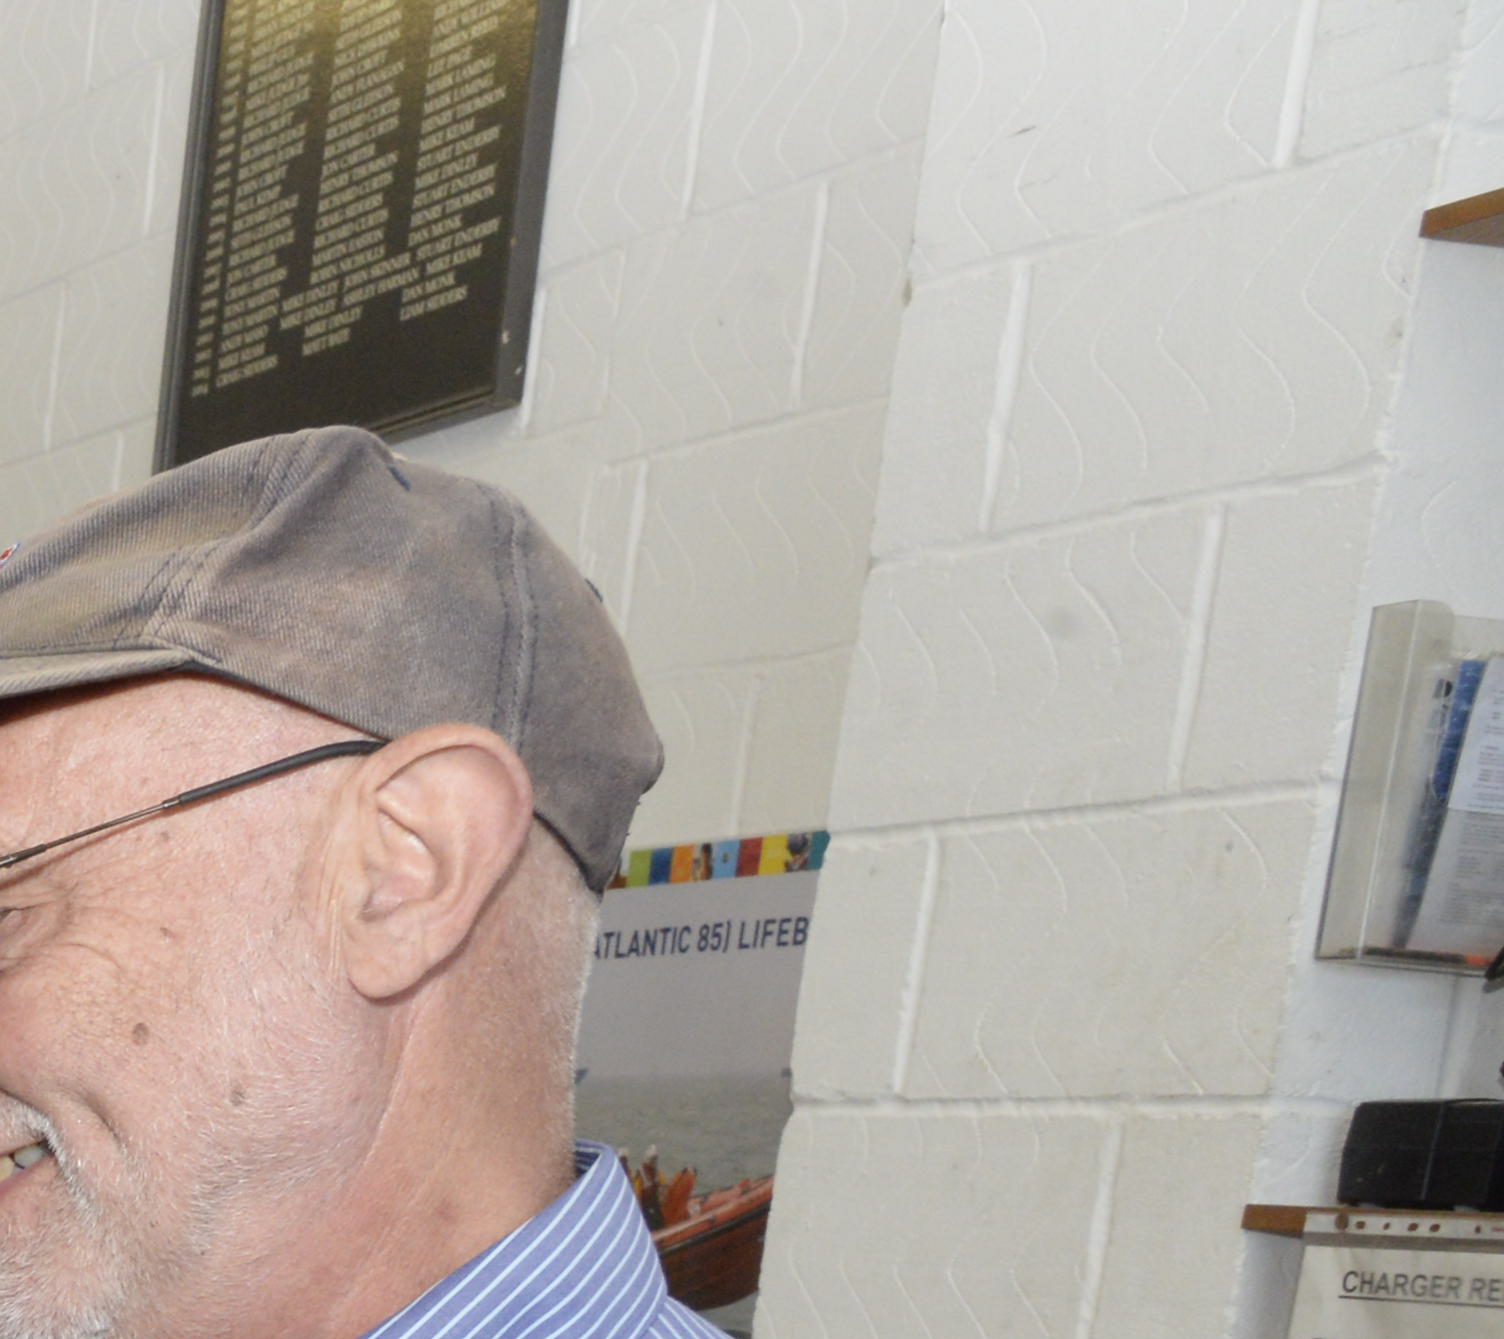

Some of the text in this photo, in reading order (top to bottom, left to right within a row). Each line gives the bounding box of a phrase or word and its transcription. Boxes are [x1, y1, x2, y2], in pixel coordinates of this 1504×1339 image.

[696, 920, 732, 953] 85)
[738, 917, 810, 949] LIFEB
[1342, 1270, 1504, 1301] CHARGER RE
